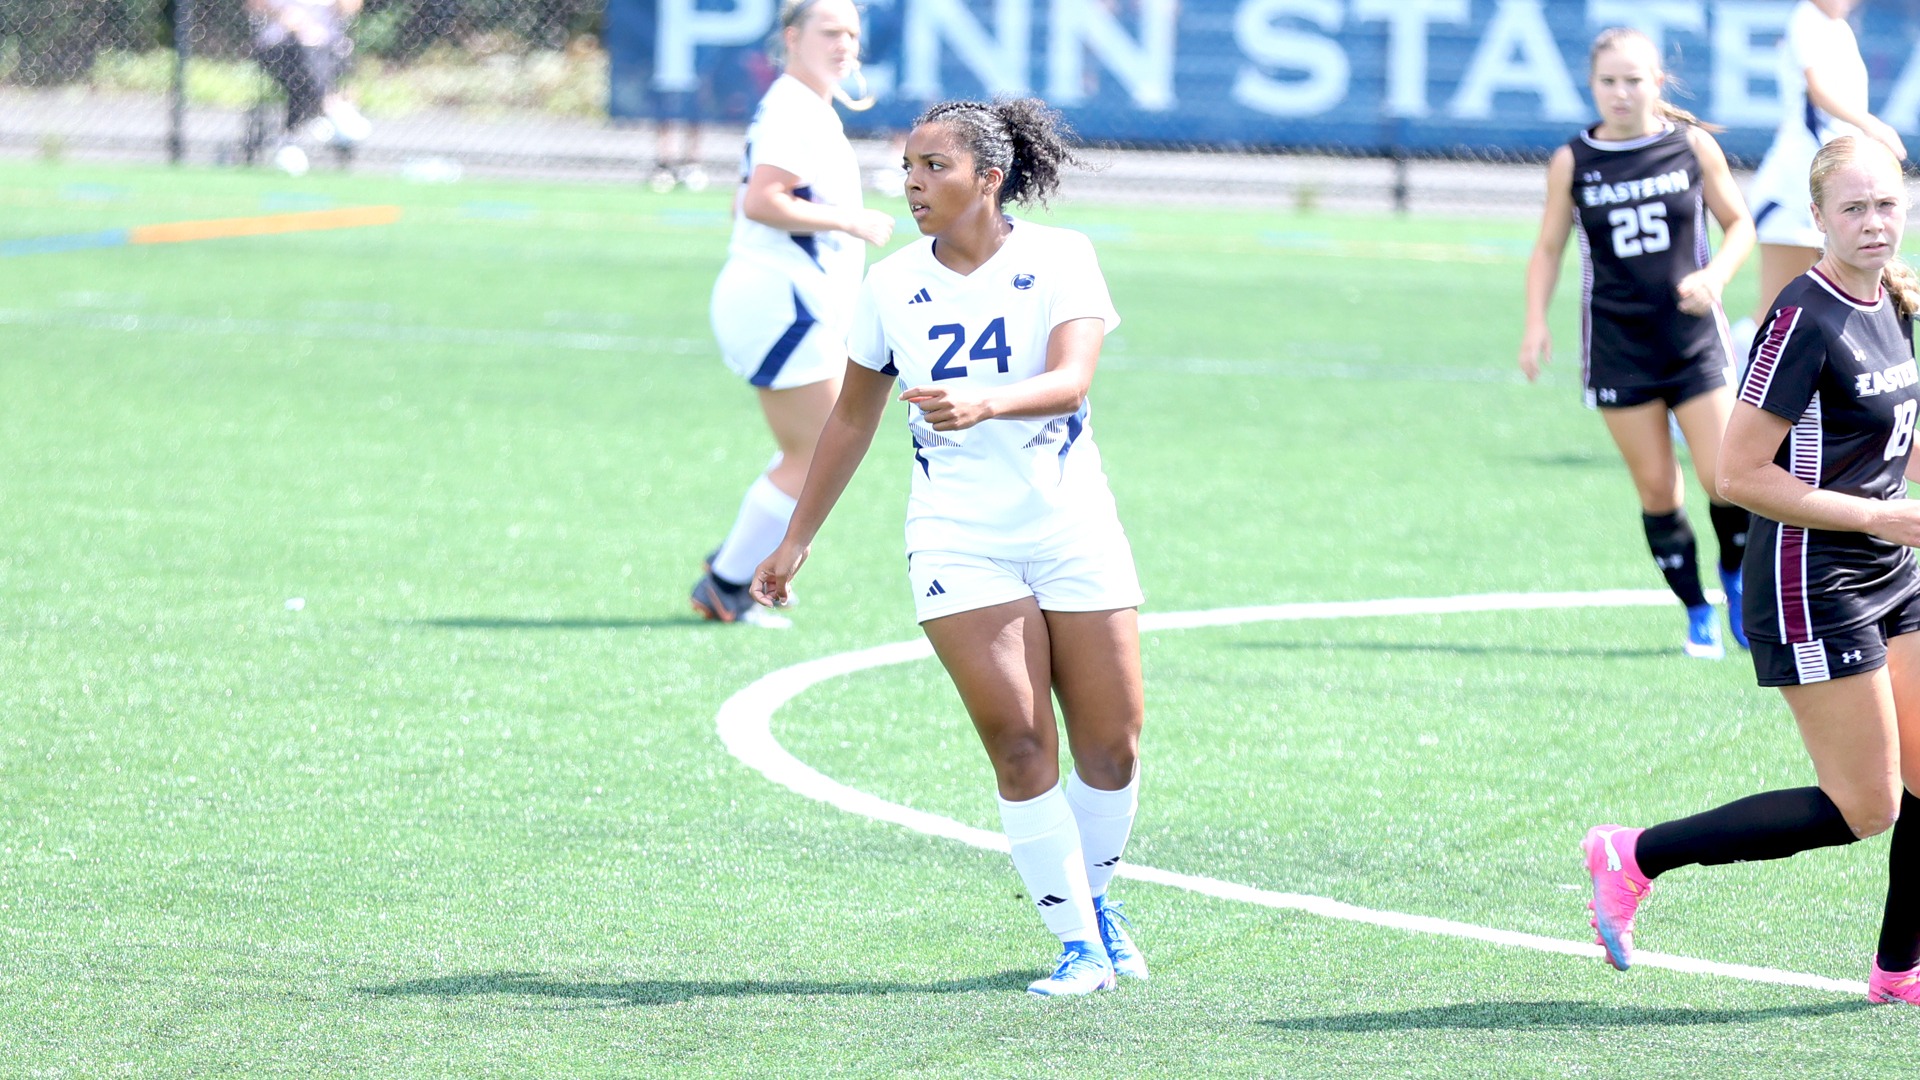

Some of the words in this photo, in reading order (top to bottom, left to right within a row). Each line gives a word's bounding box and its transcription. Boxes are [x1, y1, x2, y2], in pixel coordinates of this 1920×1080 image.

[652, 0, 1179, 111] PNN
[1583, 168, 1690, 208] EASTERN
[1608, 201, 1671, 259] 25
[928, 316, 1012, 382] 24
[1883, 398, 1917, 461] 18
